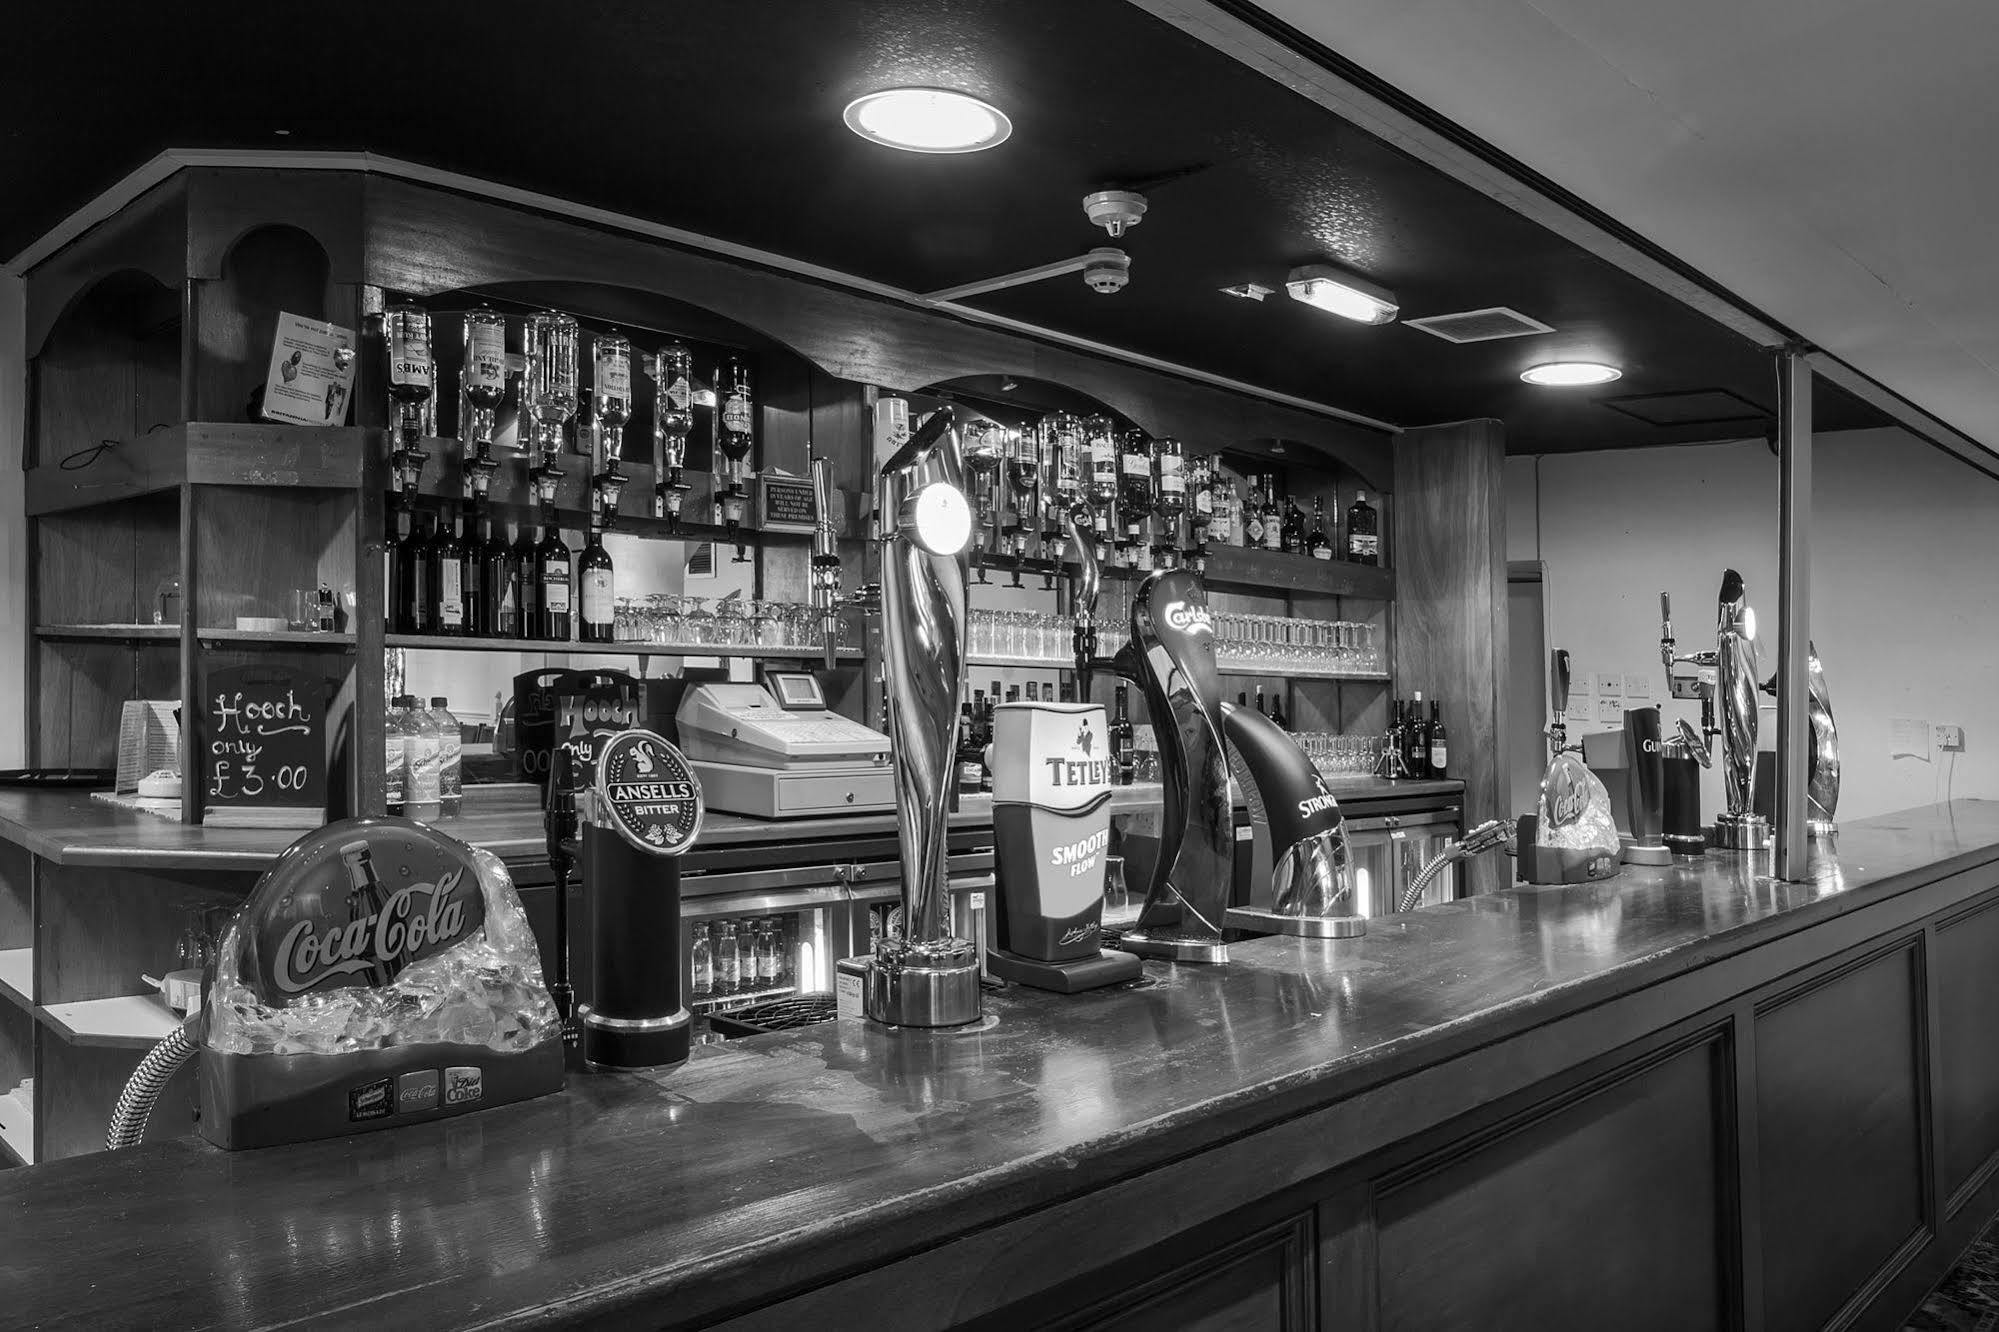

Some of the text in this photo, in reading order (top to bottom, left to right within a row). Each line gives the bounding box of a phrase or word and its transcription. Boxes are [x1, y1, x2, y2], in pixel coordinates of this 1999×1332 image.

[213, 690, 311, 734] Hooch
[560, 685, 641, 739] Hooch
[212, 740, 262, 763] only
[615, 783, 690, 800] ANSELLS
[634, 804, 680, 815] BITTER
[1051, 828, 1109, 866] SMOOTH
[1071, 855, 1097, 877] FLOW
[273, 865, 466, 993] Coca-Cola
[447, 1086, 481, 1102] Coke
